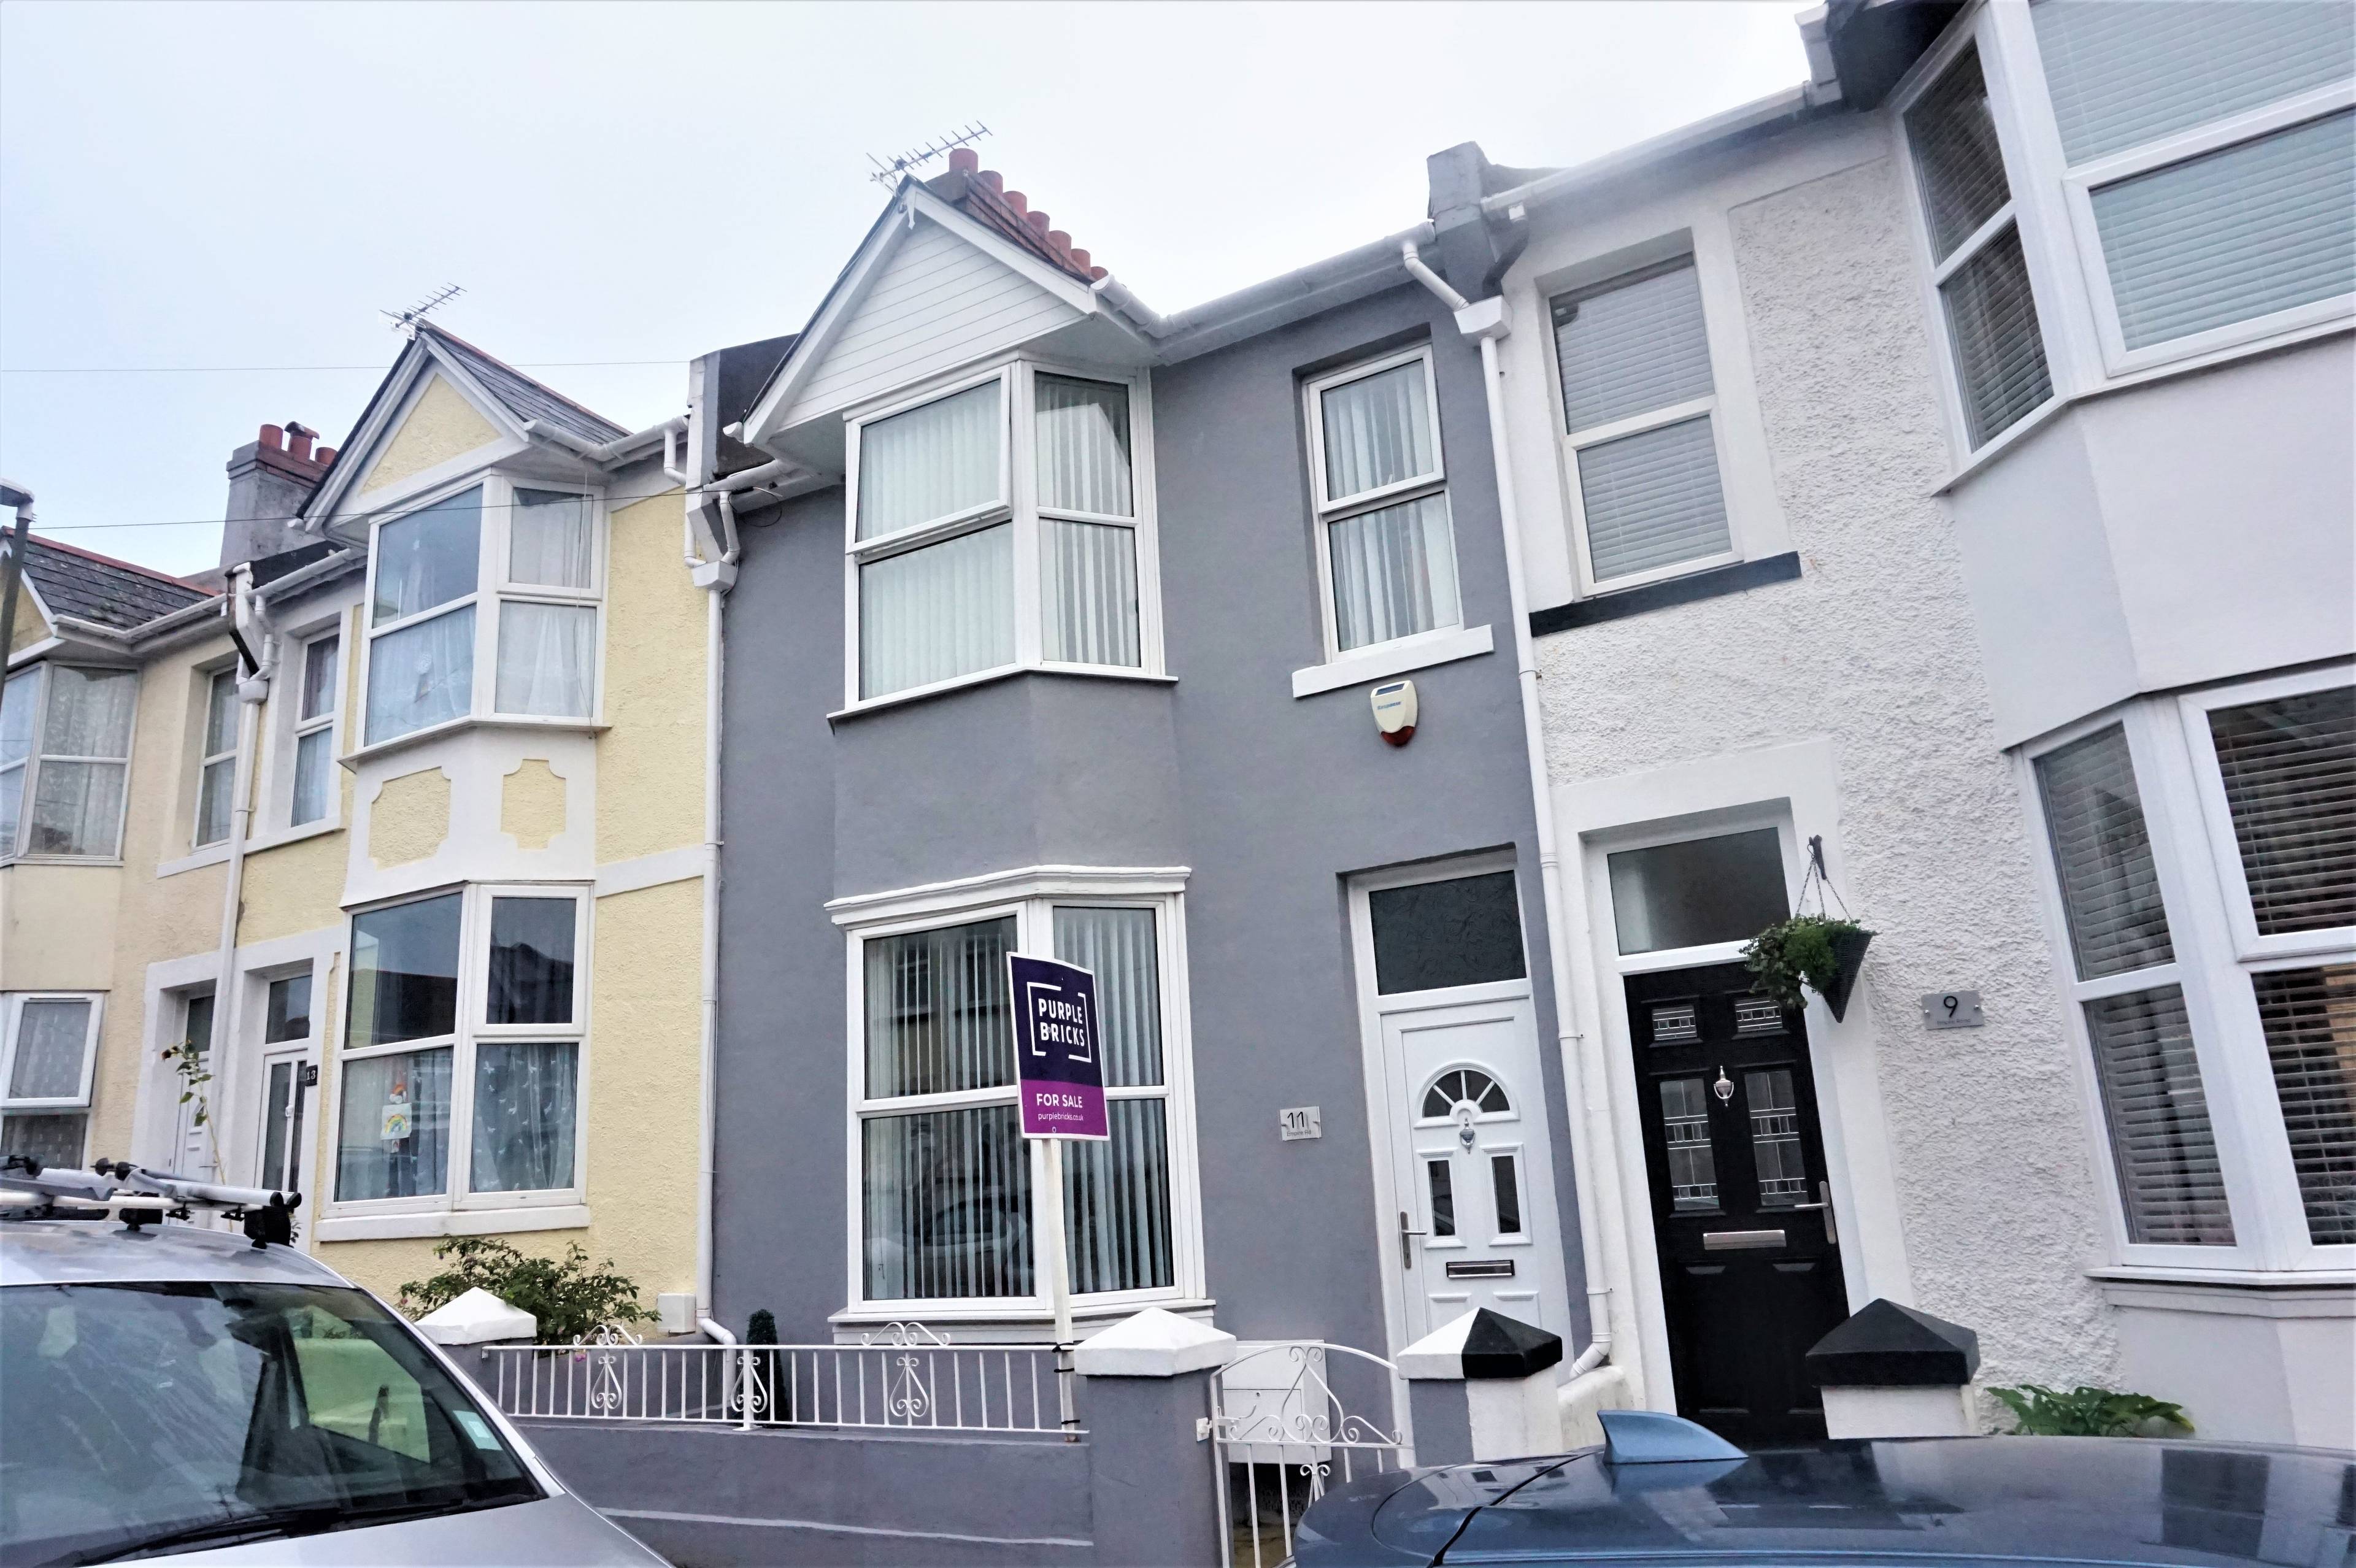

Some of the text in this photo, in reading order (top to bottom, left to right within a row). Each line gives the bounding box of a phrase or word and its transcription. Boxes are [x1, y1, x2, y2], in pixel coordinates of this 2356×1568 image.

[1038, 998, 1083, 1024] PURPLE
[1944, 996, 1958, 1018] 9
[1040, 1021, 1085, 1047] BRICKS
[307, 1070, 316, 1080] 13
[1036, 1093, 1083, 1108] FOR SALE
[1037, 1112, 1084, 1121] purplebricks.co.uk
[1287, 1111, 1304, 1129] 11
